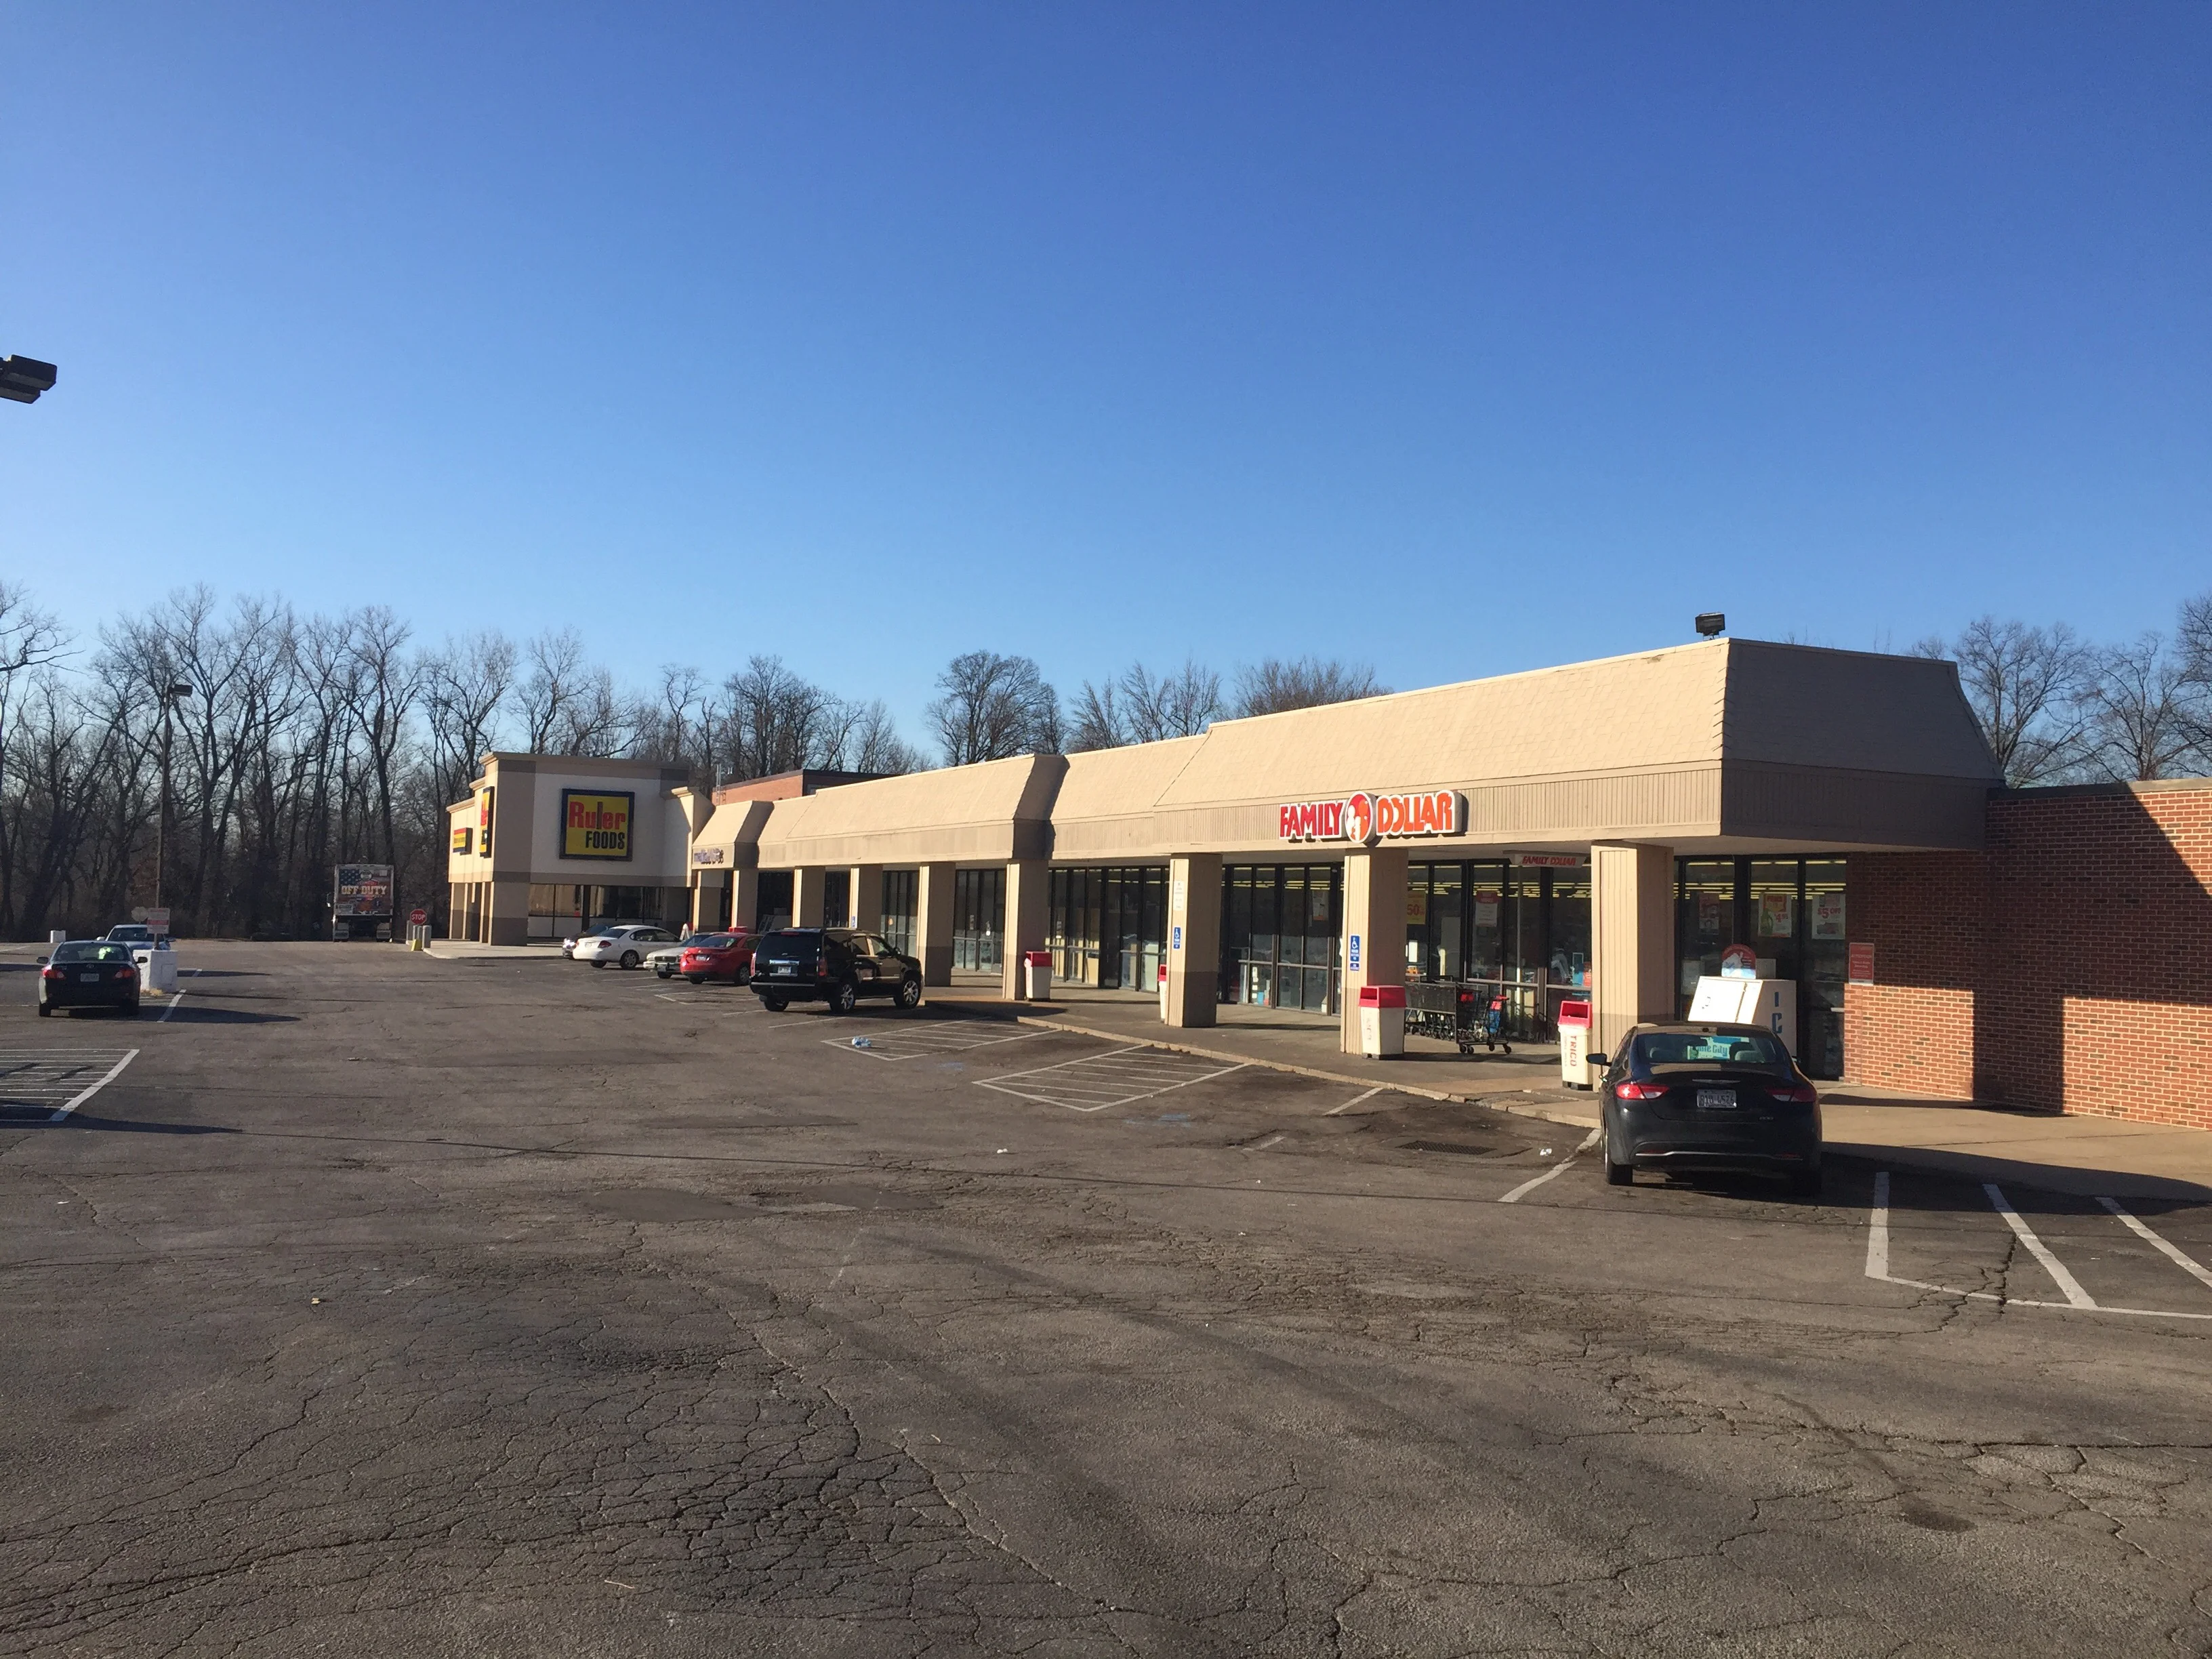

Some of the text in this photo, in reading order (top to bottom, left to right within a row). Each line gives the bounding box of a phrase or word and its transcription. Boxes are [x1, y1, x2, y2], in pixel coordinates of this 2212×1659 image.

[569, 801, 626, 830] Ruler
[1279, 791, 1454, 838] FAMILY DOLLAR
[585, 831, 626, 850] FOODS
[1521, 856, 1576, 866] FAMILY DOLLAR
[341, 885, 387, 895] OFF DUTY
[1771, 991, 1784, 1035] IC
